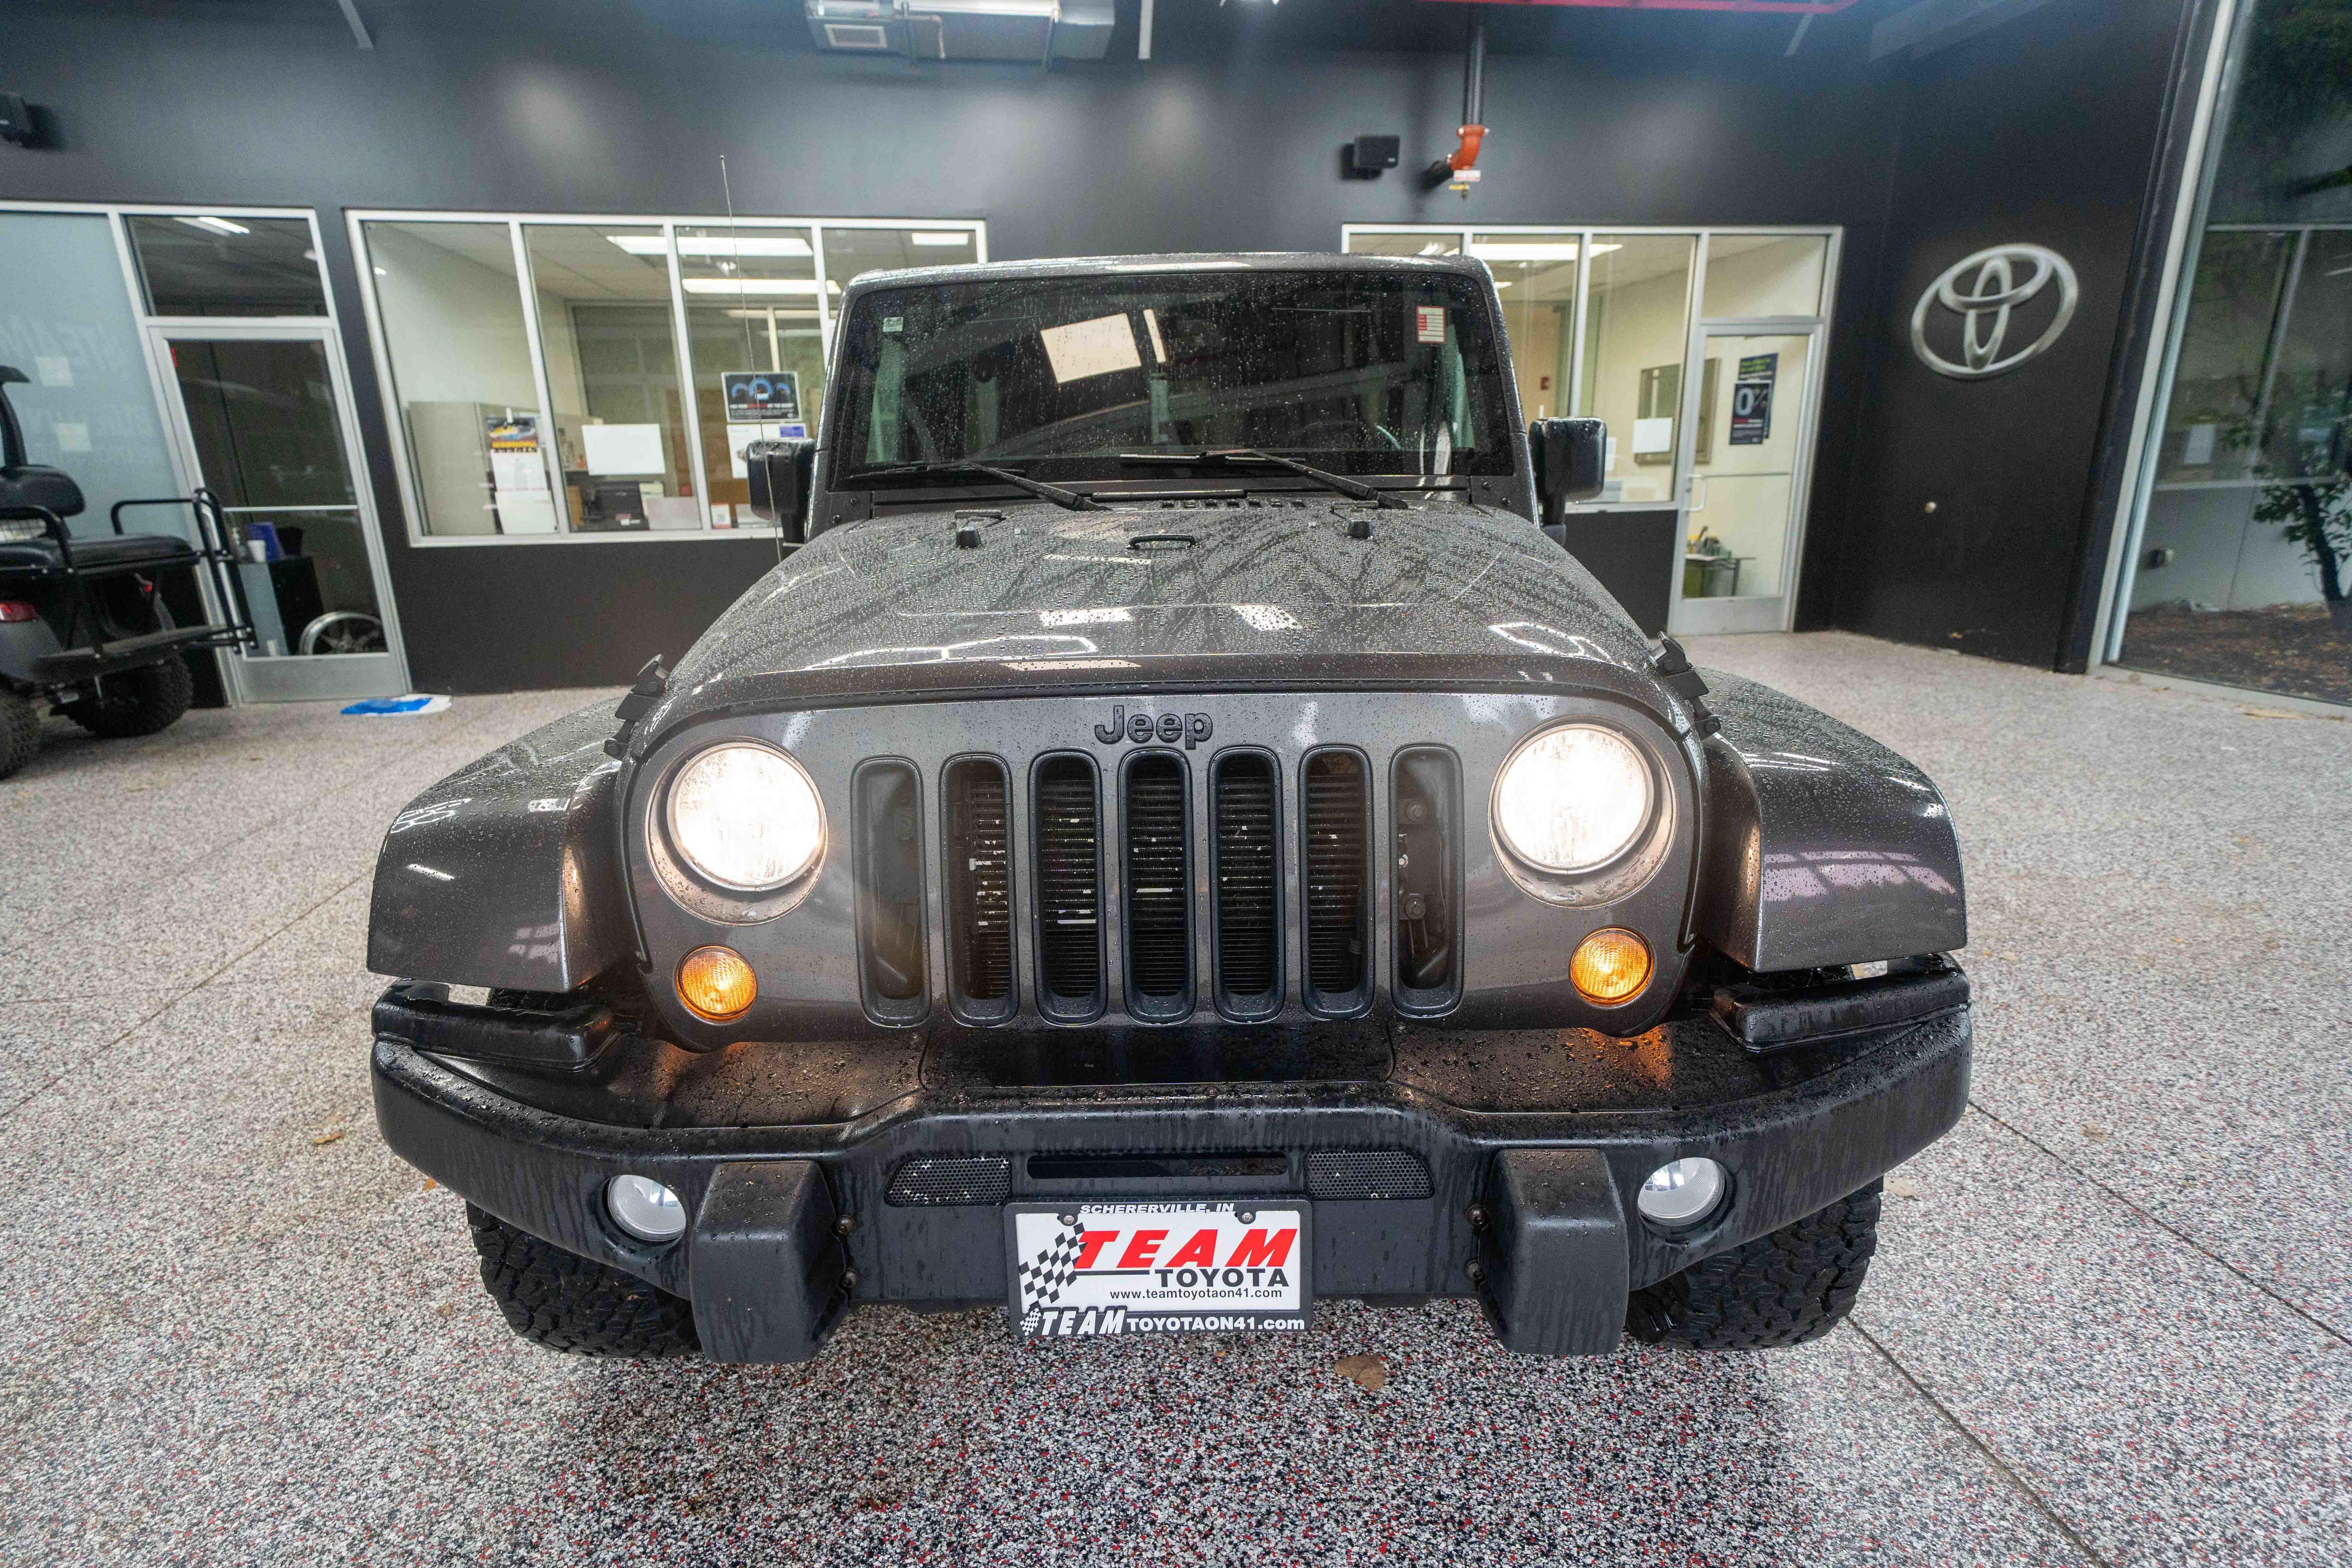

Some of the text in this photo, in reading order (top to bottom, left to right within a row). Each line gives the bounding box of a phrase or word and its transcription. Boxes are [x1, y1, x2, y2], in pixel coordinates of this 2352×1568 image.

[1094, 705, 1213, 750] Jeep
[1216, 1203, 1234, 1212] IN
[1074, 1229, 1297, 1268] TEAM
[1155, 1268, 1289, 1287] TOYOTA
[1110, 1287, 1282, 1300] www.teamtoyotaon41.com
